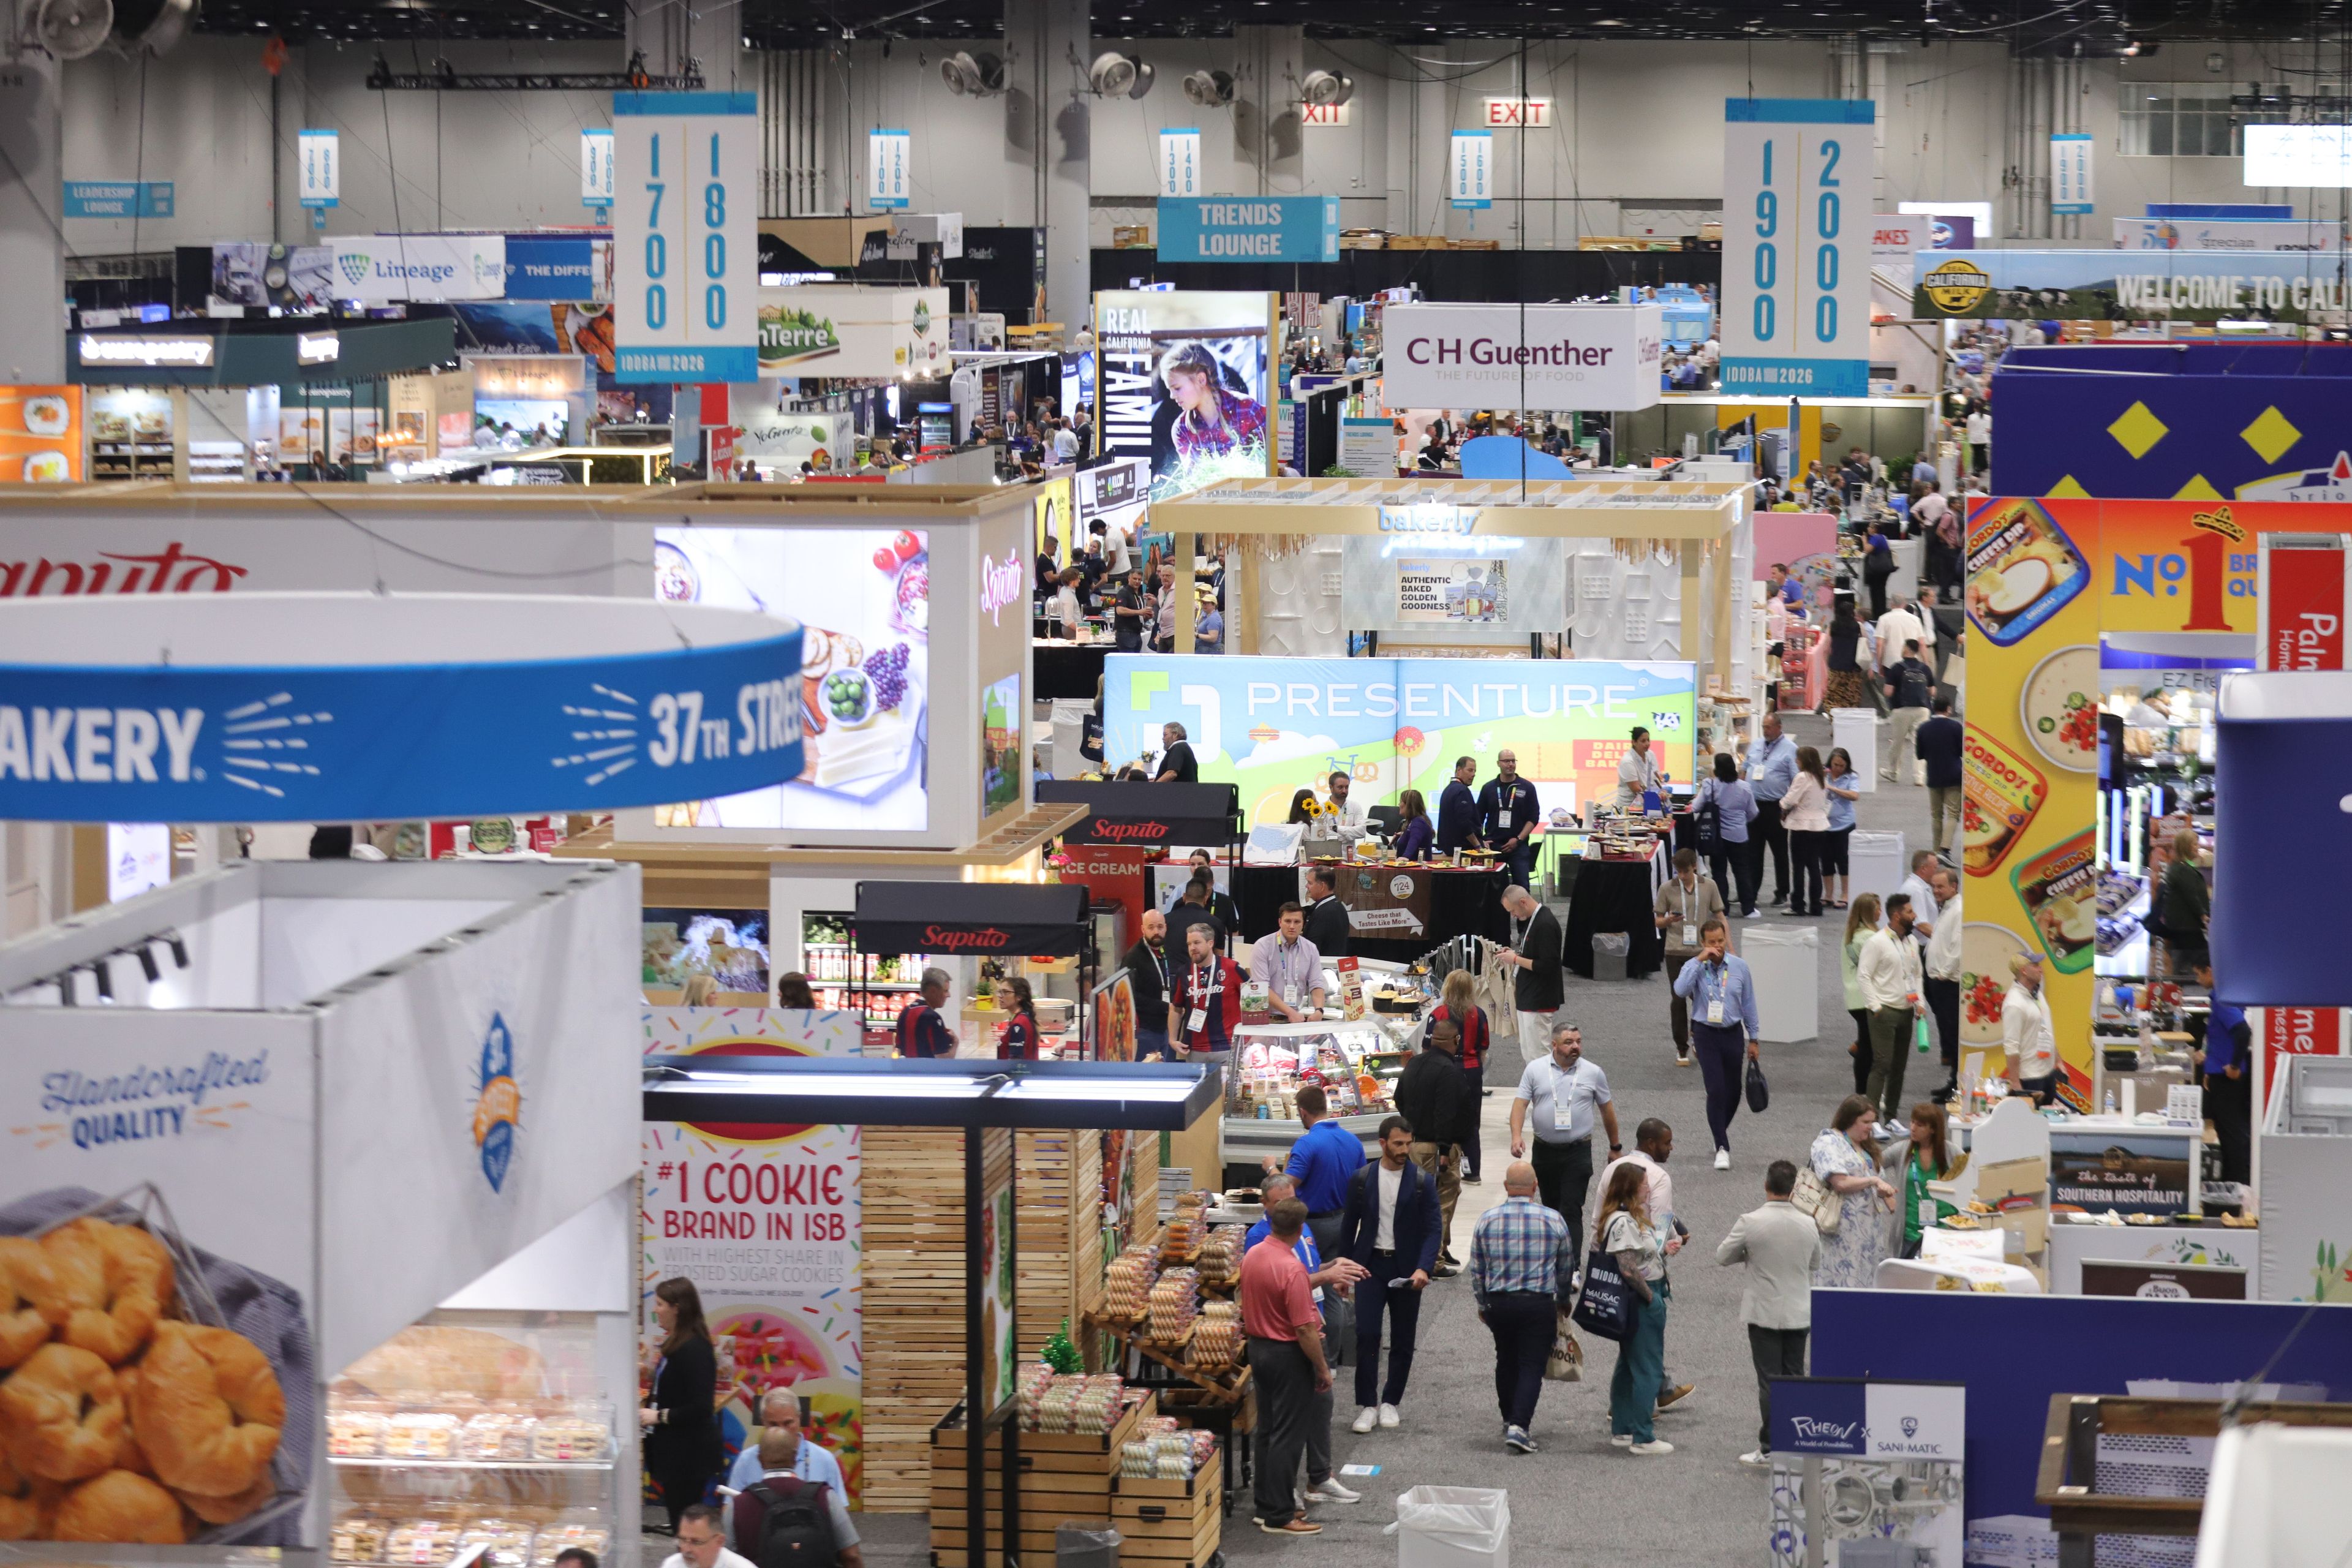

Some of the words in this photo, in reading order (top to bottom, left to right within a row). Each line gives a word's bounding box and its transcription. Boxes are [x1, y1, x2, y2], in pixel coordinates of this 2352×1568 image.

[1490, 103, 1545, 123] EXIT
[83, 201, 124, 213] LOUNGE
[1199, 203, 1283, 227] TRENDS
[645, 131, 667, 331] 1700
[704, 131, 727, 331] 1800
[1754, 139, 1778, 343] 1900
[1815, 139, 1841, 344] 2000
[1199, 233, 1282, 256] LOUNGE
[375, 260, 455, 283] Lineage
[526, 265, 552, 277] THE
[1927, 274, 1986, 287] CALIFORNIA
[2115, 274, 2245, 309] WELCOME
[2250, 275, 2285, 310] TO
[1106, 307, 1152, 335] REAL
[1106, 336, 1152, 350] CALIFORNIA
[672, 354, 705, 372] 2026
[1435, 370, 1461, 381] THE
[1466, 370, 1519, 381] FUTURE
[1524, 371, 1542, 381] OF
[1546, 371, 1585, 382] FOOD
[1726, 366, 1763, 383] IDDBA
[1780, 368, 1813, 384] 2026
[1378, 505, 1480, 537] bakerly
[1967, 537, 2008, 572] CHEESE
[2006, 522, 2026, 543] DIP
[1400, 563, 1431, 573] bakerly
[981, 548, 1024, 628] Saputo
[2026, 596, 2057, 620] ORIGINAL
[2163, 673, 2188, 687] EZ
[1247, 682, 1638, 718] PRESENTURE
[0, 708, 205, 782] AKERY
[1591, 750, 1623, 759] DEL
[1593, 742, 1632, 751] DAIR
[1992, 778, 2008, 791] DIP
[1090, 819, 1169, 843] Saputo
[1061, 862, 1085, 875] ICE
[1088, 862, 1140, 875] CREAM
[1394, 881, 1410, 892] 724
[2045, 867, 2087, 897] CHEESE
[920, 924, 1011, 953] Saputo
[41, 1048, 271, 1115] Handcrafted
[72, 1104, 189, 1150] QUALITY
[657, 1161, 688, 1204] #1
[704, 1162, 844, 1206] COOKIE
[2142, 1172, 2157, 1190] of
[2057, 1187, 2113, 1202] SOUTHERN
[2115, 1189, 2184, 1204] HOSPITALITY
[664, 1210, 756, 1240] BRAND
[767, 1212, 793, 1240] IN
[804, 1213, 846, 1241] ISB
[665, 1246, 701, 1262] WITH
[706, 1248, 769, 1265] HIGHEST
[776, 1250, 823, 1265] SHARE
[829, 1250, 844, 1265] IN
[664, 1264, 726, 1281] FROSTED
[729, 1266, 778, 1282] SUGAR
[782, 1267, 844, 1283] COOKIES
[1790, 1416, 1857, 1439] RHEON
